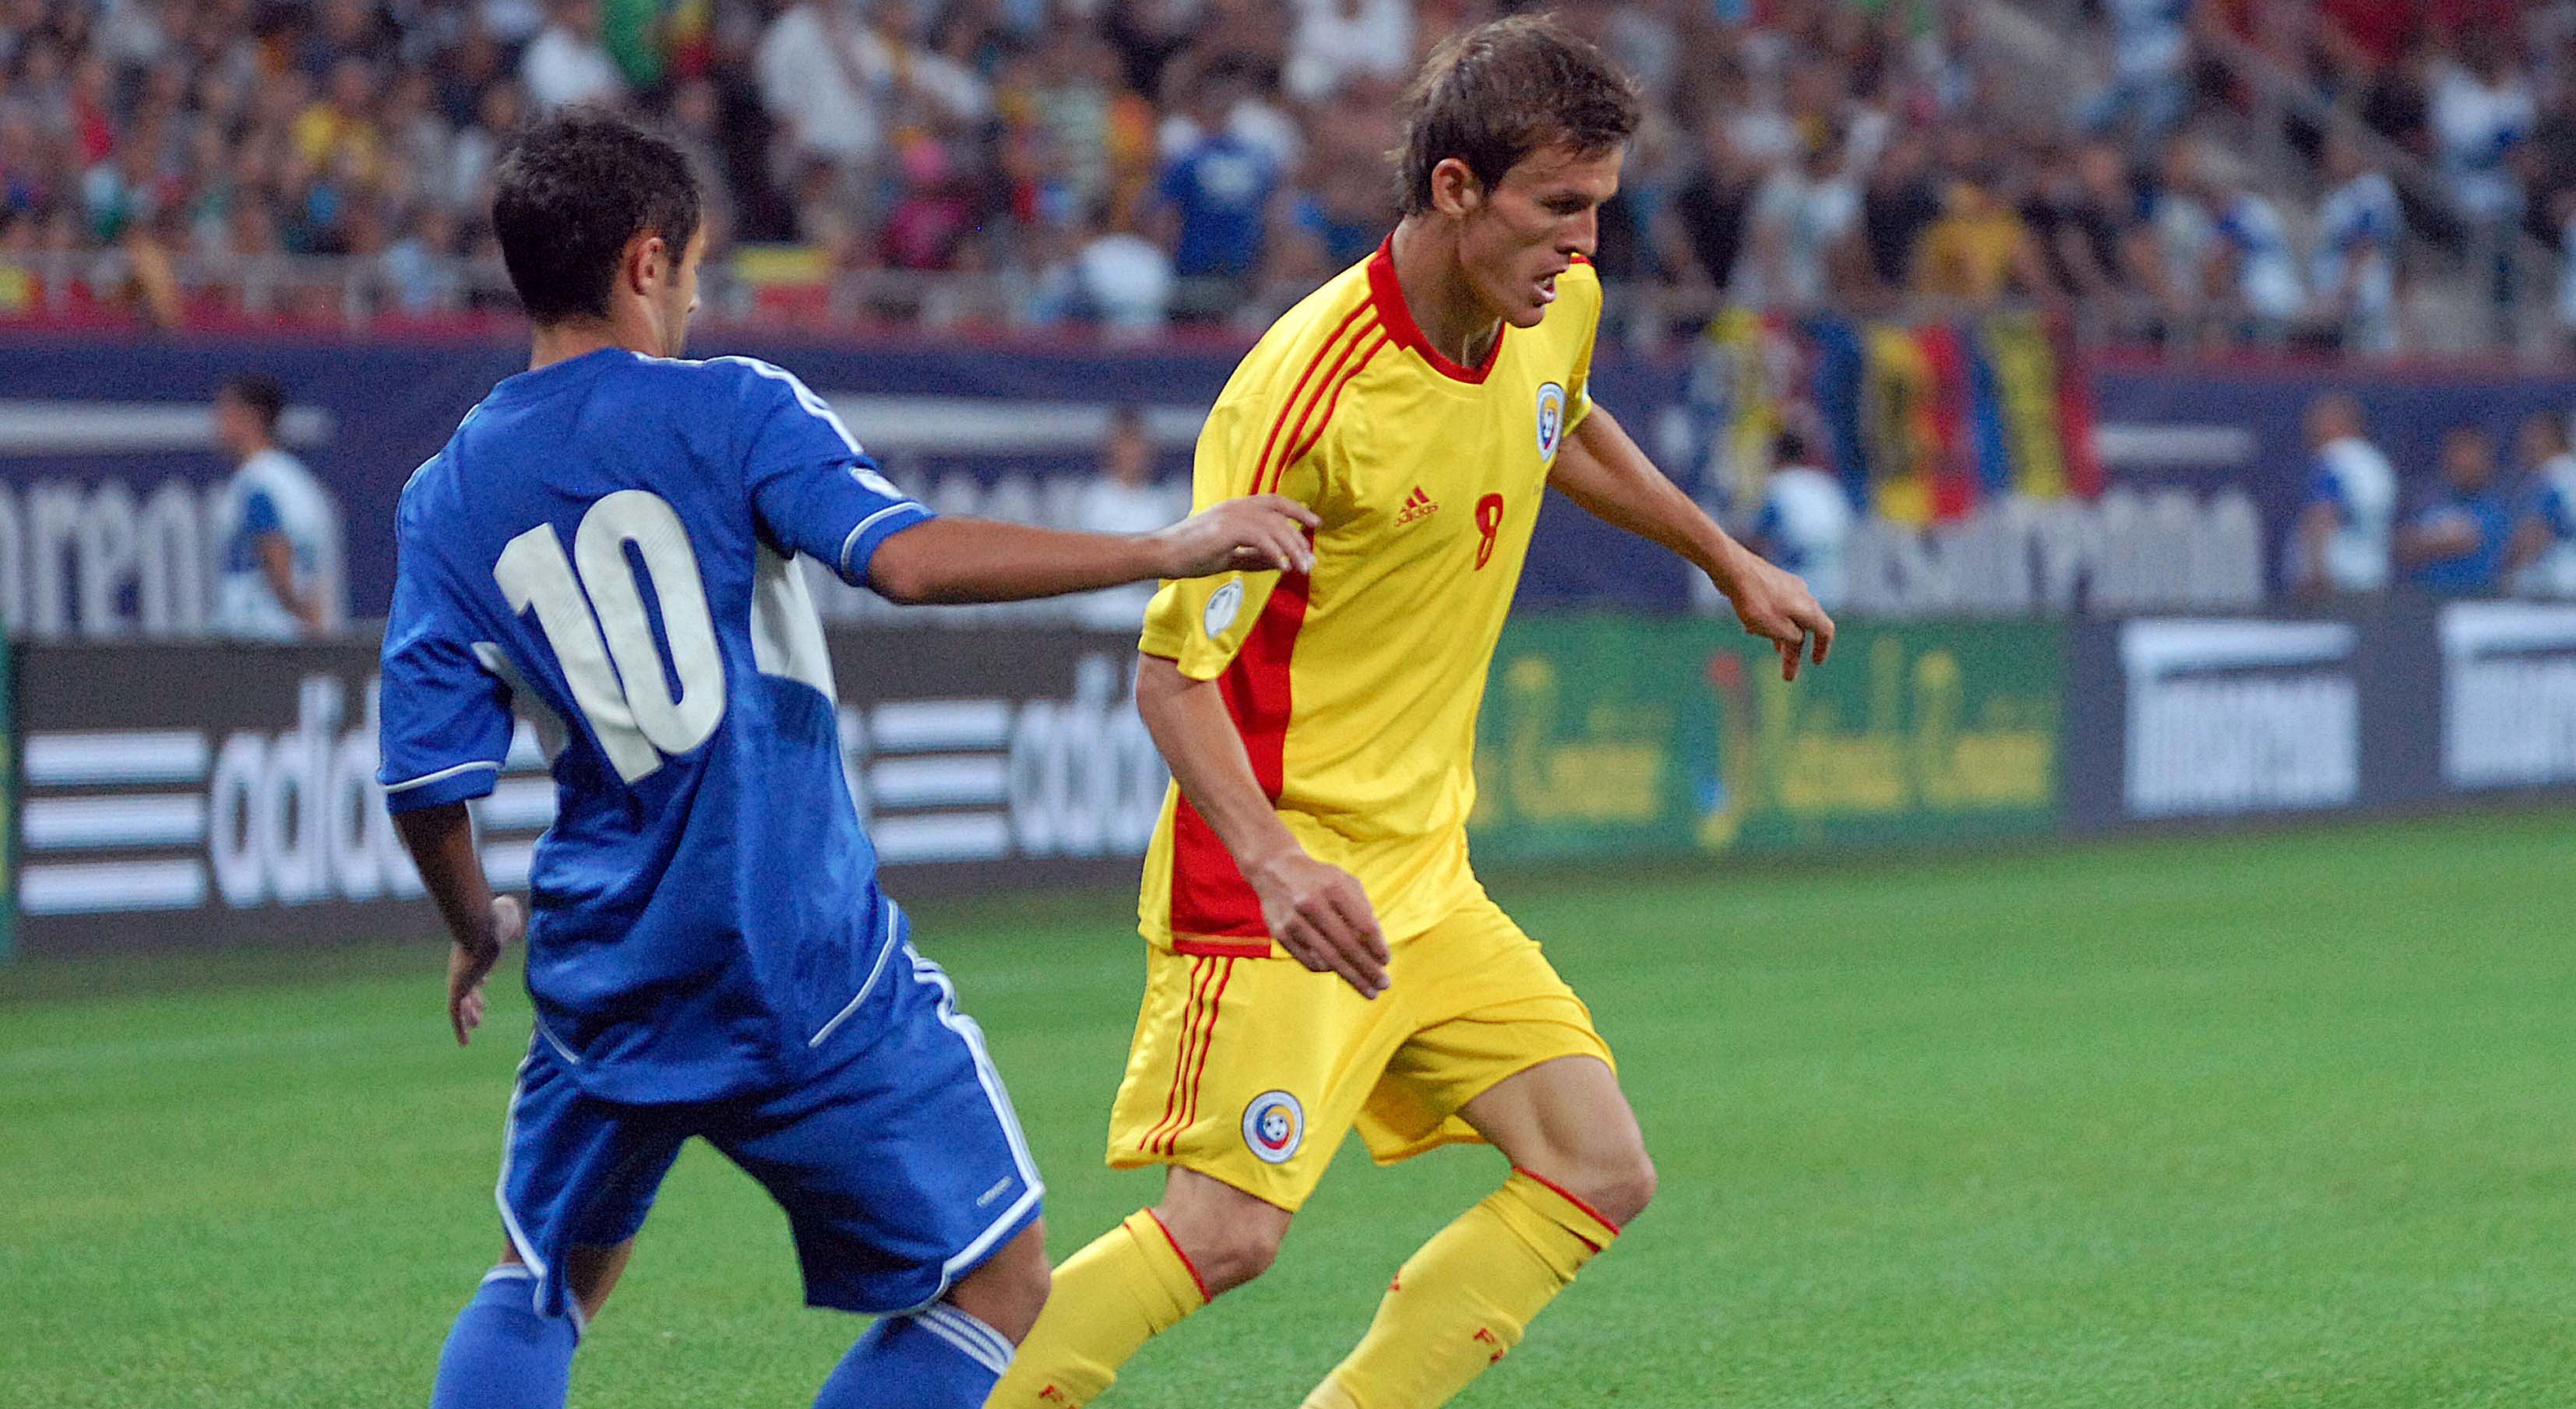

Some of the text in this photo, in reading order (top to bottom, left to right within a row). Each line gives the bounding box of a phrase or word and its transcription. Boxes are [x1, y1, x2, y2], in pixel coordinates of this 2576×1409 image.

[492, 489, 727, 784] 10
[1475, 491, 1504, 572] 8
[212, 674, 428, 910] adid
